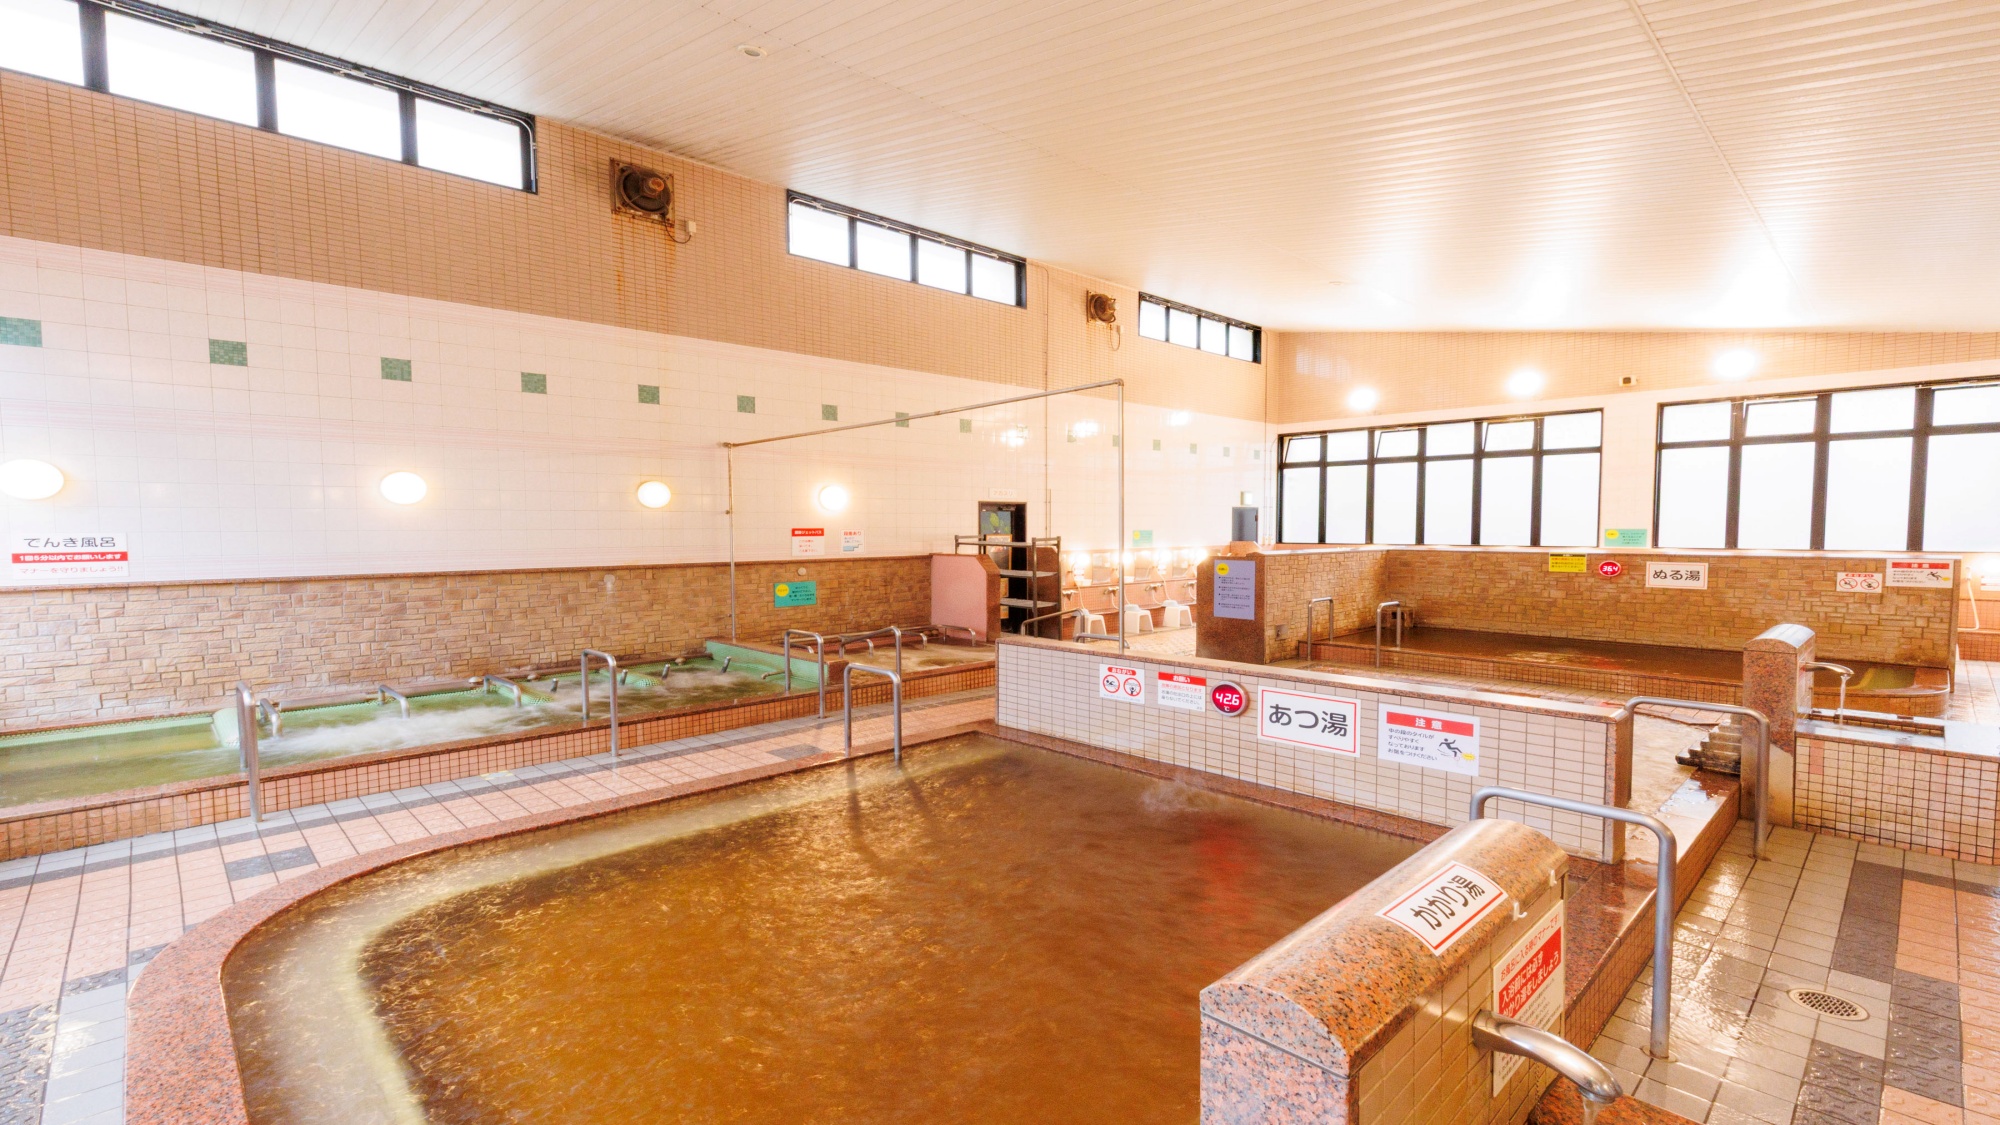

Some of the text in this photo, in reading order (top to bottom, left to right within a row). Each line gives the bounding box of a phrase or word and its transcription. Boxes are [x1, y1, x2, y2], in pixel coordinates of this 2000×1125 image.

[24, 537, 116, 548] でんき風呂
[1652, 569, 1701, 581] ぬる湯
[1215, 692, 1240, 706] 42.6
[1269, 703, 1348, 737] あつ湯
[1388, 734, 1420, 744] すべりやすく
[1388, 741, 1424, 752] なっております
[1409, 875, 1486, 930] かかり湯
